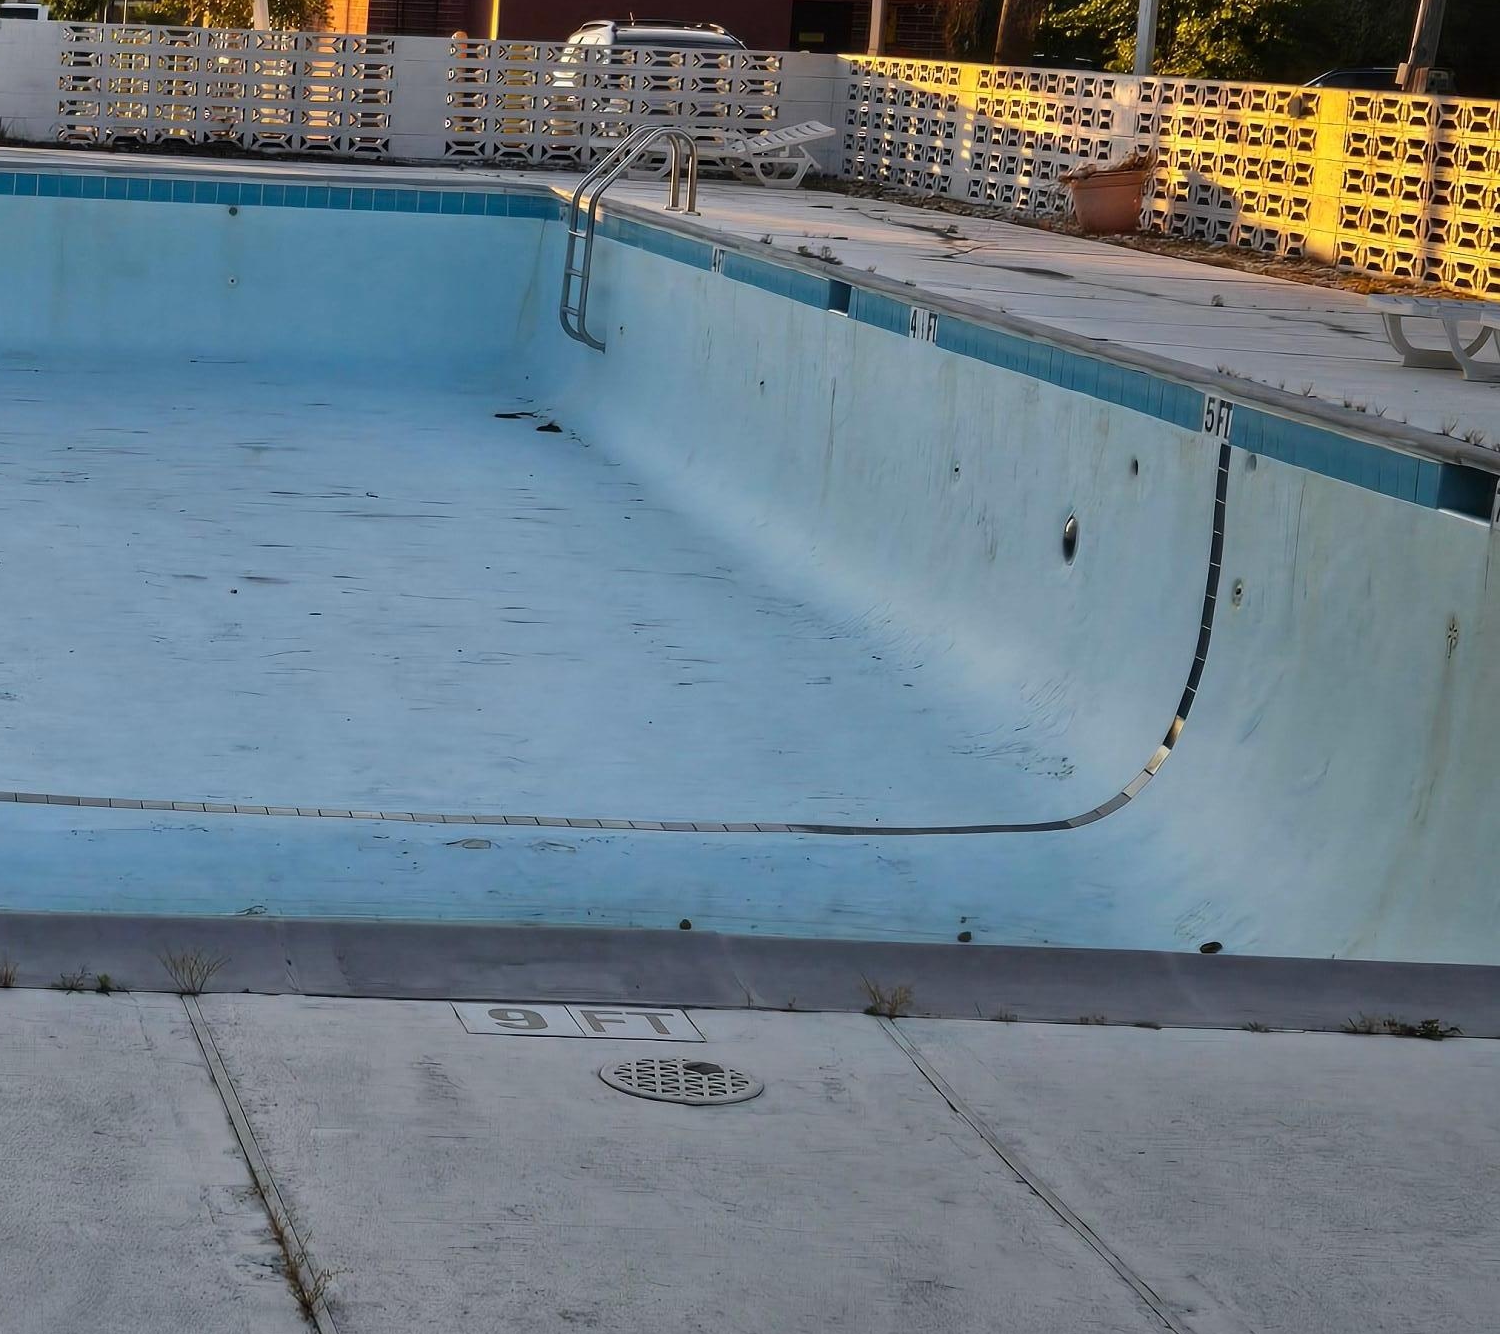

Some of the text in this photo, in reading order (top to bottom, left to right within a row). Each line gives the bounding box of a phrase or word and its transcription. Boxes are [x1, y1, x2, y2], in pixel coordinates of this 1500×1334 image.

[1205, 397, 1234, 439] 5 FT
[488, 1008, 674, 1034] 9 FT
